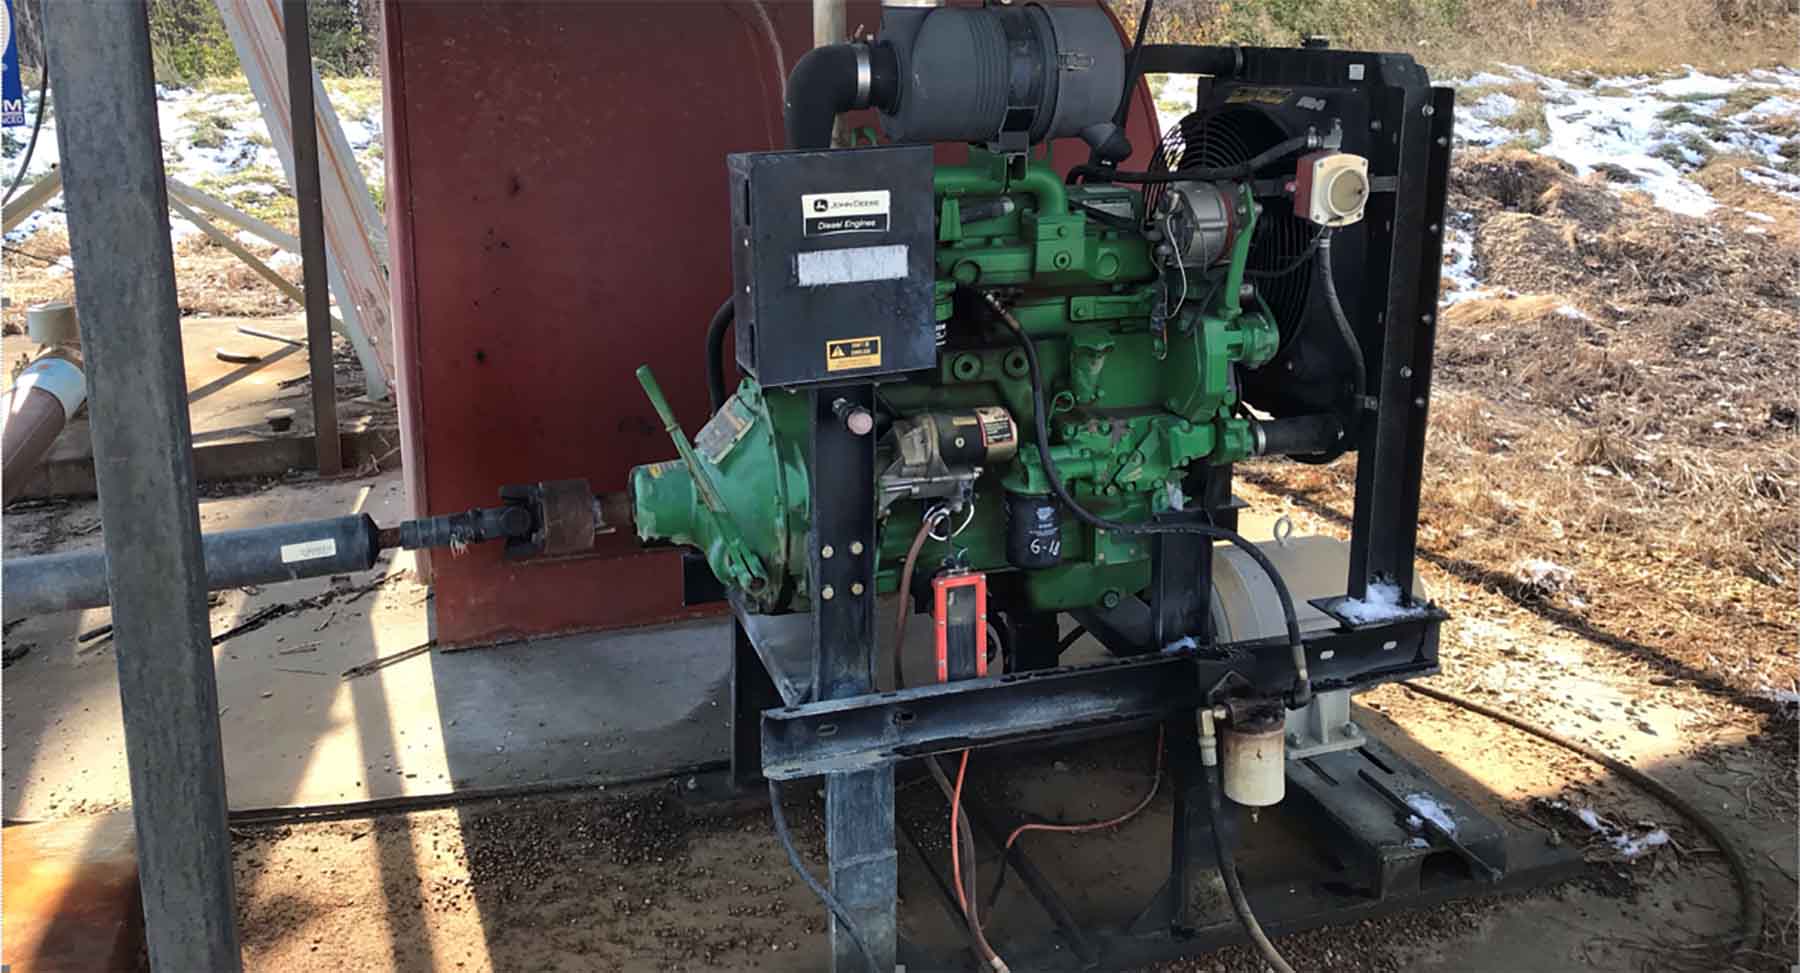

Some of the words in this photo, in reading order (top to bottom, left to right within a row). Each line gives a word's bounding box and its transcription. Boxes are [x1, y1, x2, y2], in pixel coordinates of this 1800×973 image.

[831, 200, 853, 209] JOHN
[853, 199, 879, 208] DEERE
[817, 220, 843, 230] Diesel
[844, 219, 876, 229] Engines
